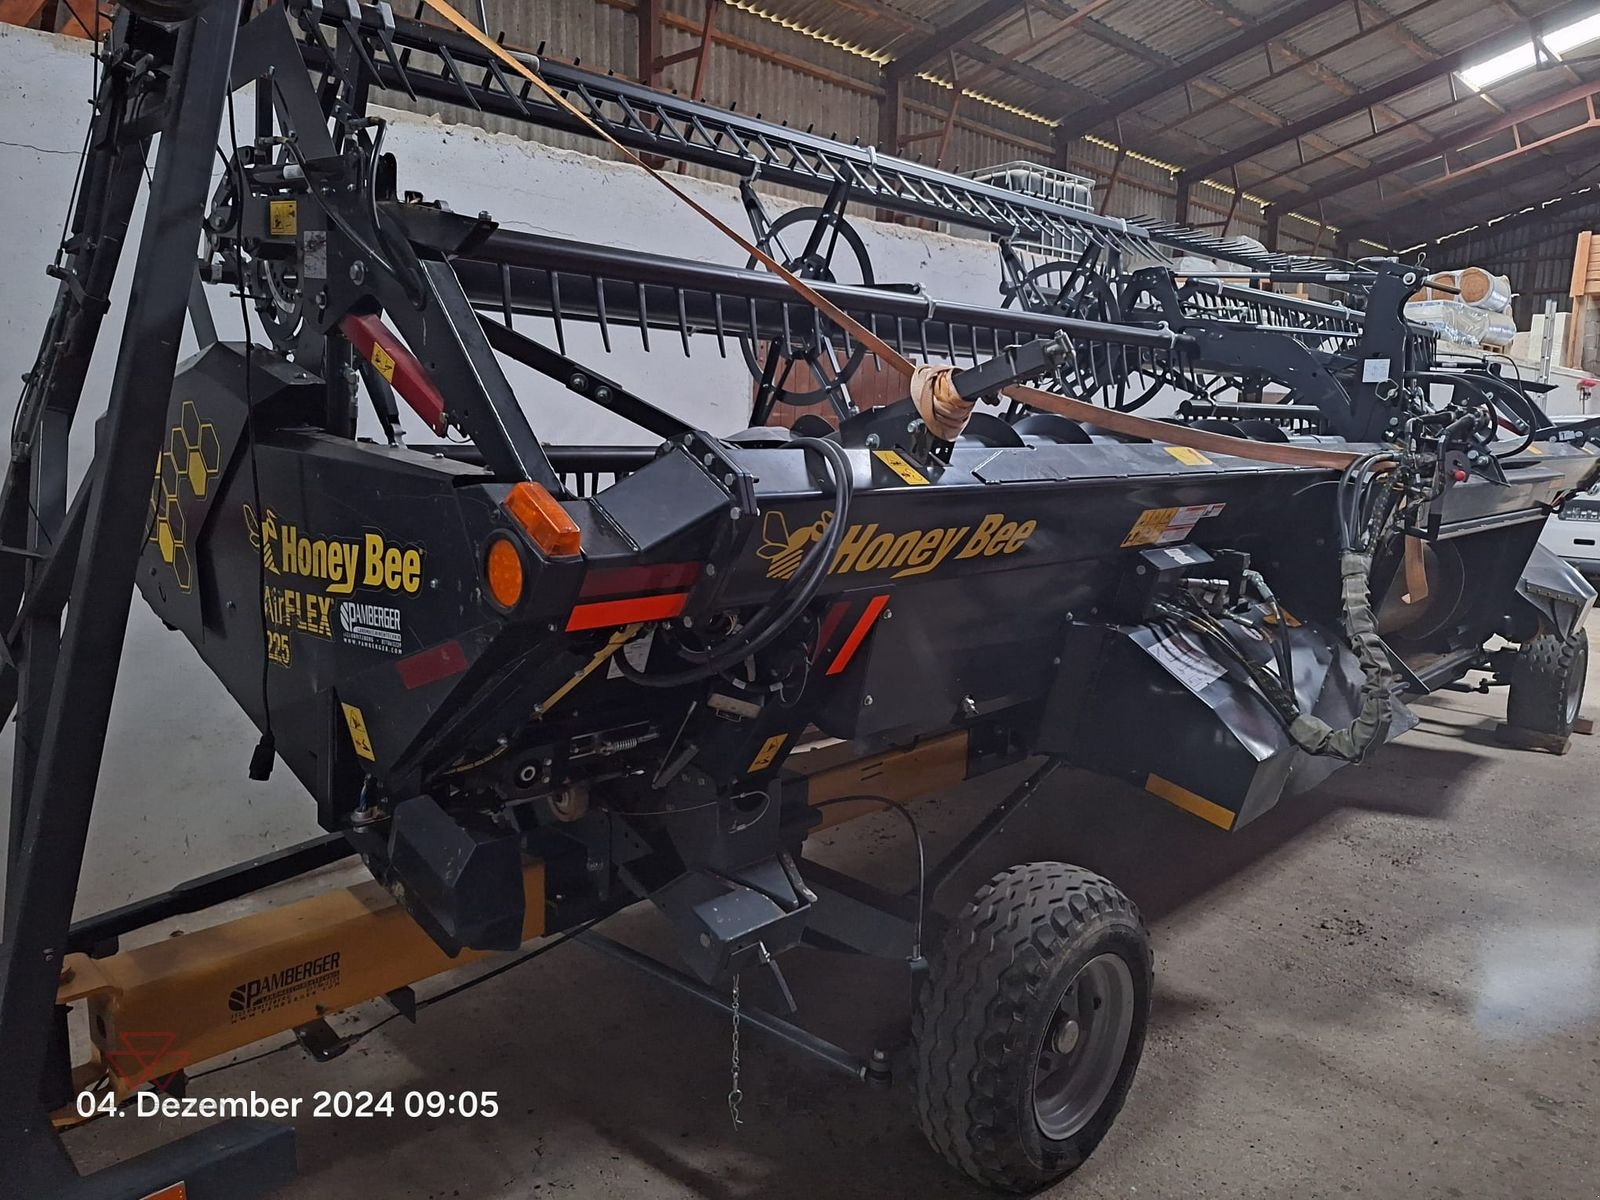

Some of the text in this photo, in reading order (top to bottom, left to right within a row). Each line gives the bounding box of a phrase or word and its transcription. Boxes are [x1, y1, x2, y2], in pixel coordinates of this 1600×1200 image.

[281, 525, 421, 593] Honey Bee
[827, 513, 1037, 579] Honey Bee
[267, 630, 290, 664] 225
[246, 951, 340, 1008] PAMBERGER
